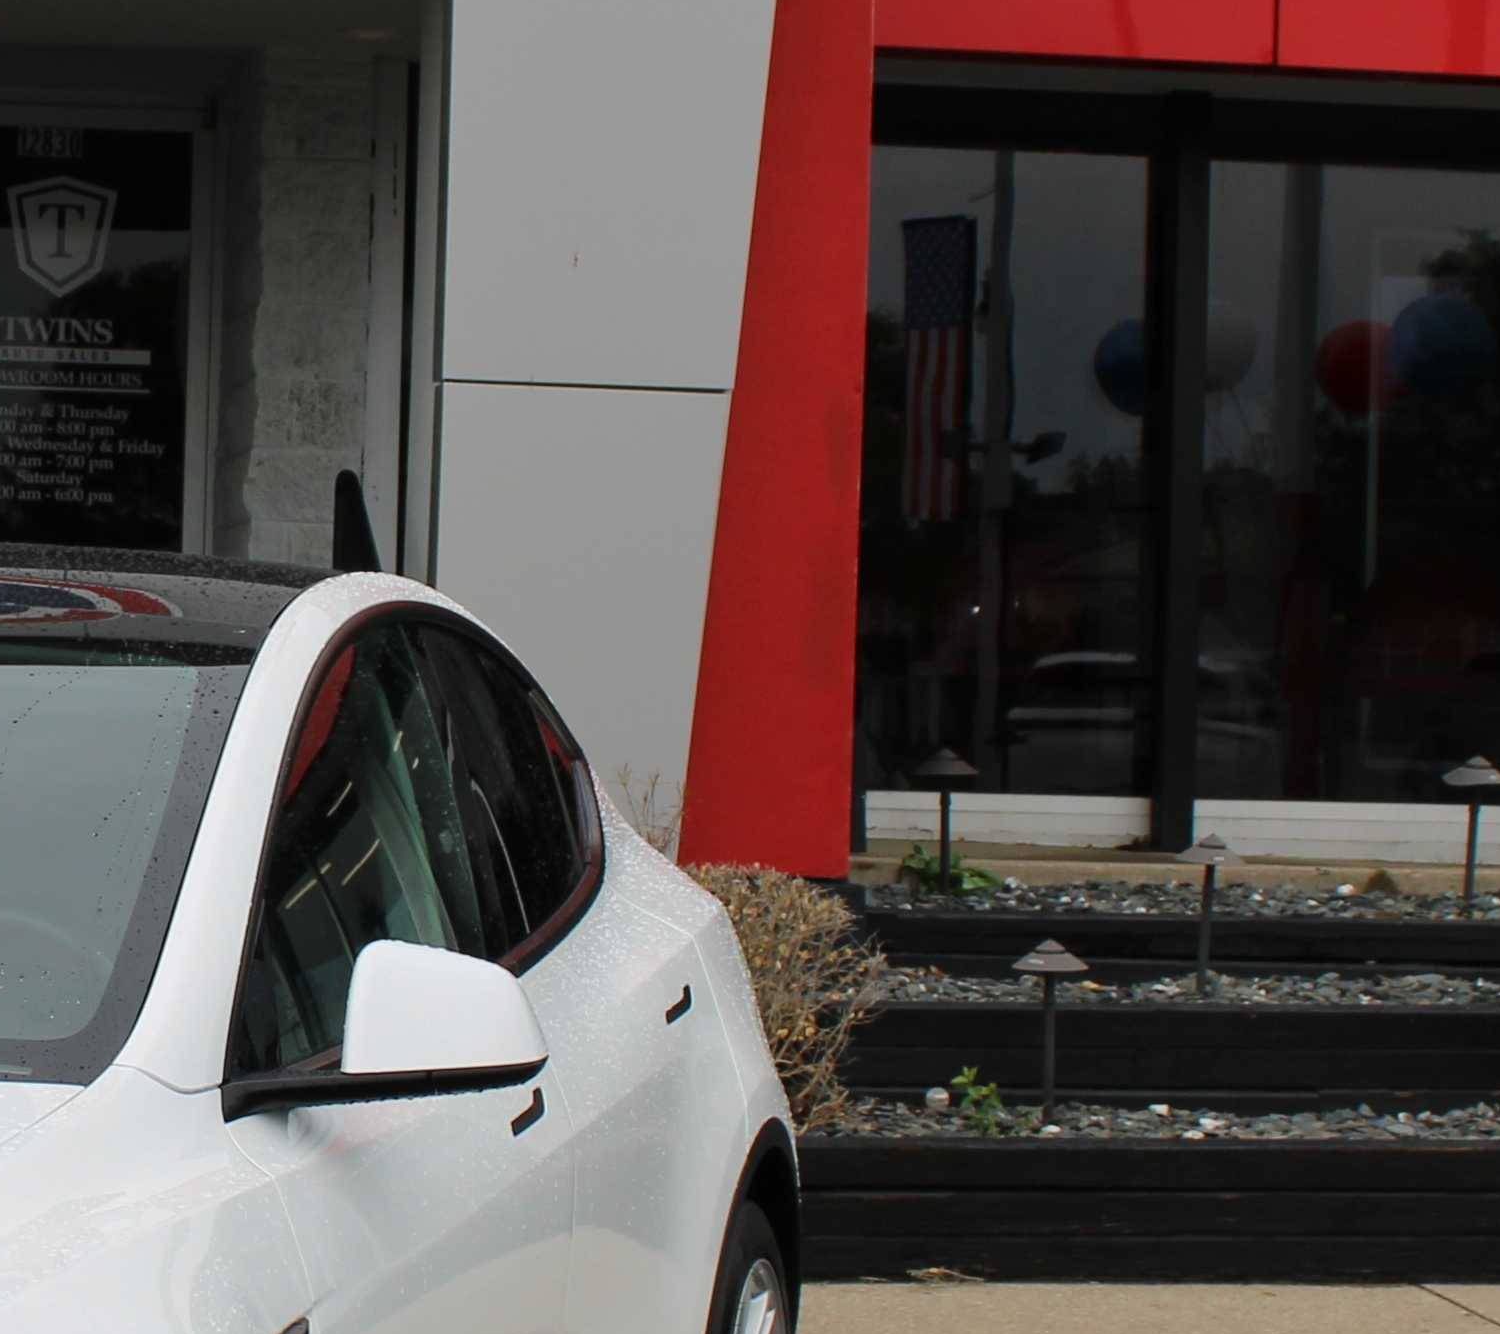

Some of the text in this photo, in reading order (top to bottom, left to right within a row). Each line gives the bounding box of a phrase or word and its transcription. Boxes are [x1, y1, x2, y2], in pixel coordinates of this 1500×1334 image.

[38, 203, 85, 259] T
[0, 316, 114, 344] TWINS
[0, 348, 112, 363] AUTO SALES
[79, 370, 143, 387] HOURS
[40, 404, 55, 417] &
[60, 404, 131, 423] Thursday
[20, 423, 43, 434] am
[56, 421, 86, 435] 8:00
[90, 425, 115, 438] pm
[8, 437, 94, 453] Wednesday
[99, 441, 113, 453] &
[118, 439, 167, 458] Friday
[20, 456, 43, 467] am
[56, 454, 86, 468] 7:00
[89, 458, 114, 473] pm
[15, 470, 84, 487] Saturday
[18, 489, 42, 501] am
[54, 487, 84, 502] 6:00
[88, 491, 113, 506] pm
